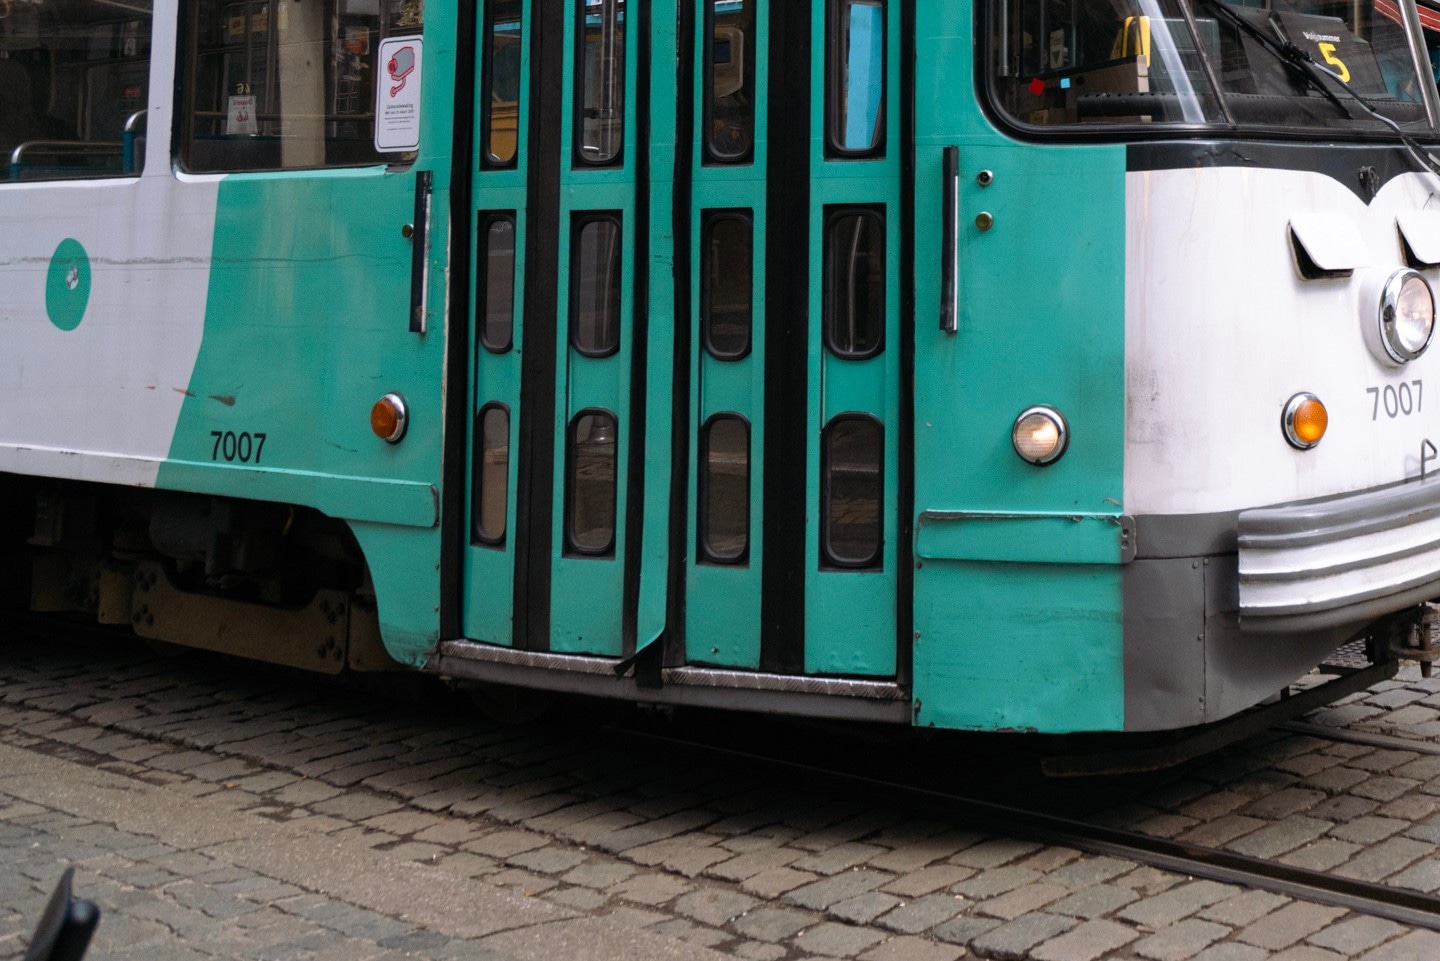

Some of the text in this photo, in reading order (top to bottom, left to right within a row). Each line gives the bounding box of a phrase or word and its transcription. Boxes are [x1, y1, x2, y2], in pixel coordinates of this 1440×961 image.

[1318, 42, 1351, 83] 5
[1366, 379, 1423, 421] 7007
[210, 431, 267, 464] 7007
